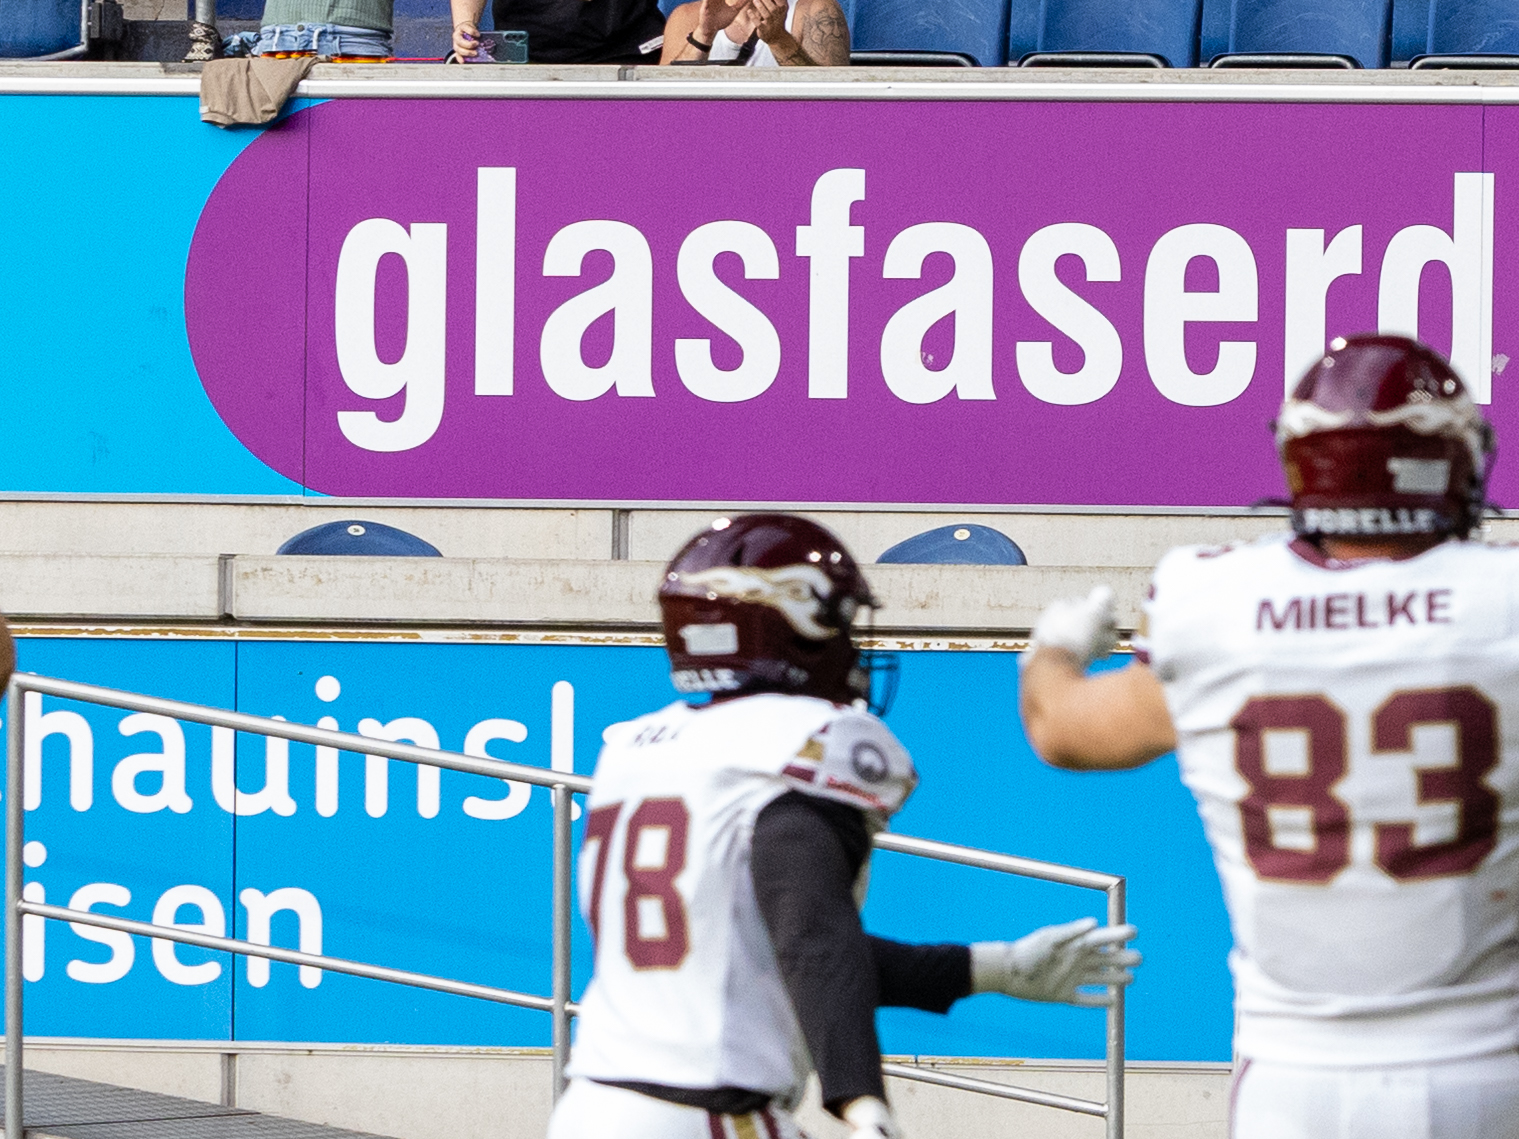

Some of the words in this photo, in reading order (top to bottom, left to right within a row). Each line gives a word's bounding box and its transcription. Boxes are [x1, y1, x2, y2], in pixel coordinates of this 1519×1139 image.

[1256, 589, 1454, 632] MIELKE
[0, 673, 622, 820] hauinsl
[1232, 686, 1501, 885] 83
[585, 797, 690, 971] 78
